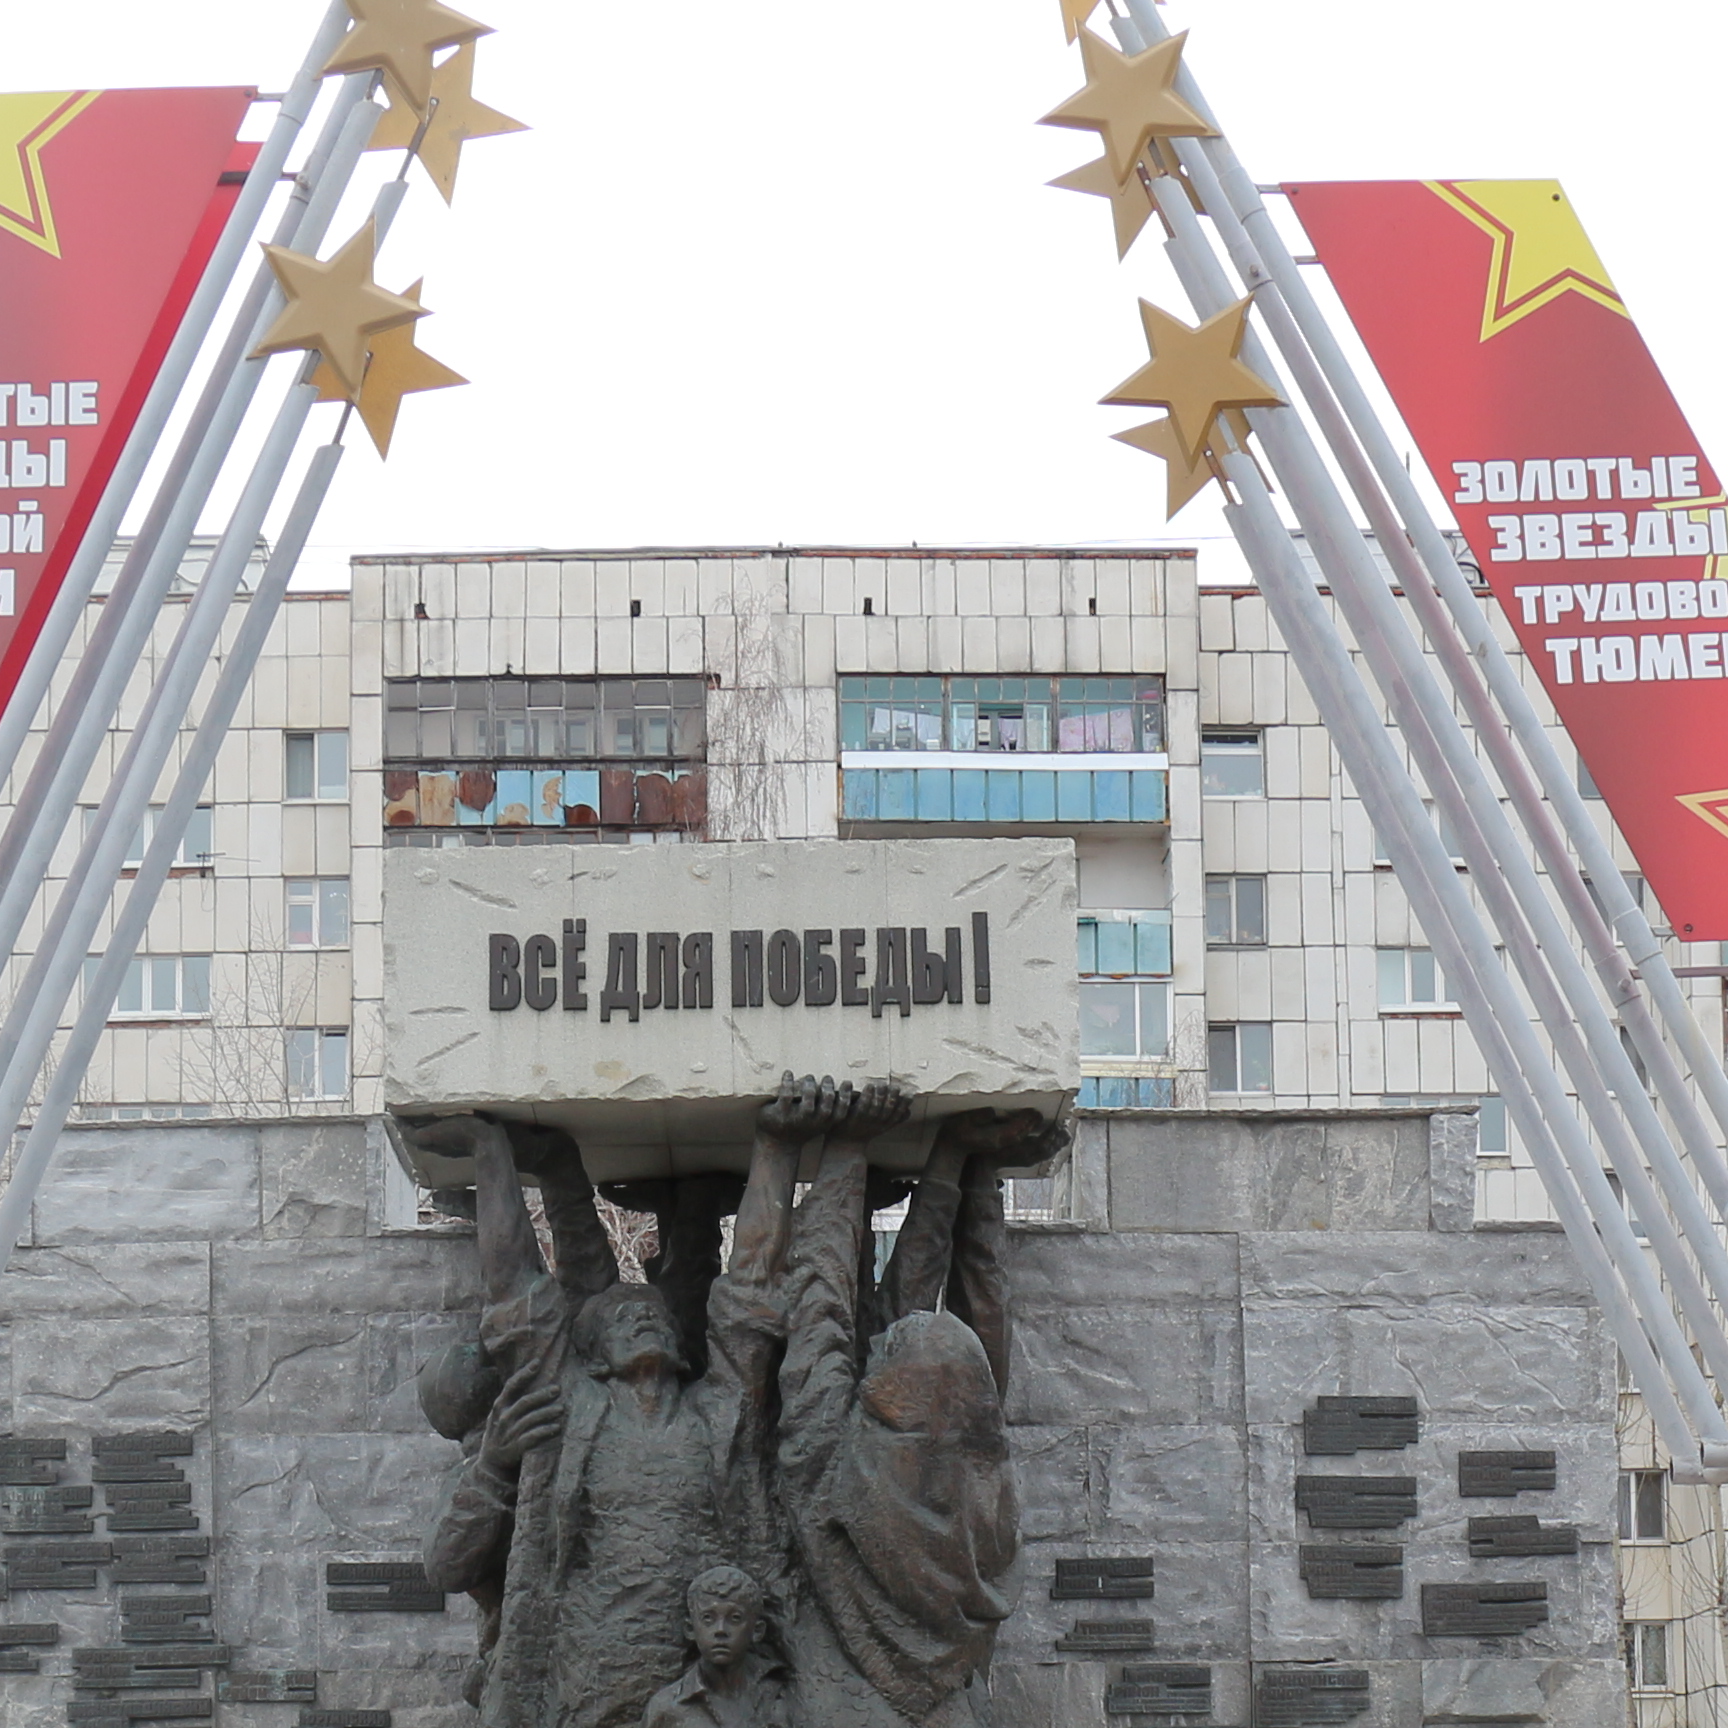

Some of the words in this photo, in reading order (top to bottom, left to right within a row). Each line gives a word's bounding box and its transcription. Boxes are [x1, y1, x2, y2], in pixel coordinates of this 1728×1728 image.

[1452, 456, 1701, 503] ЗОЛОТЫЕ
[489, 918, 588, 1011] ВСЁ
[600, 932, 713, 1023] ДЛЯ
[731, 911, 991, 1019] ПОБЕДЫ!
